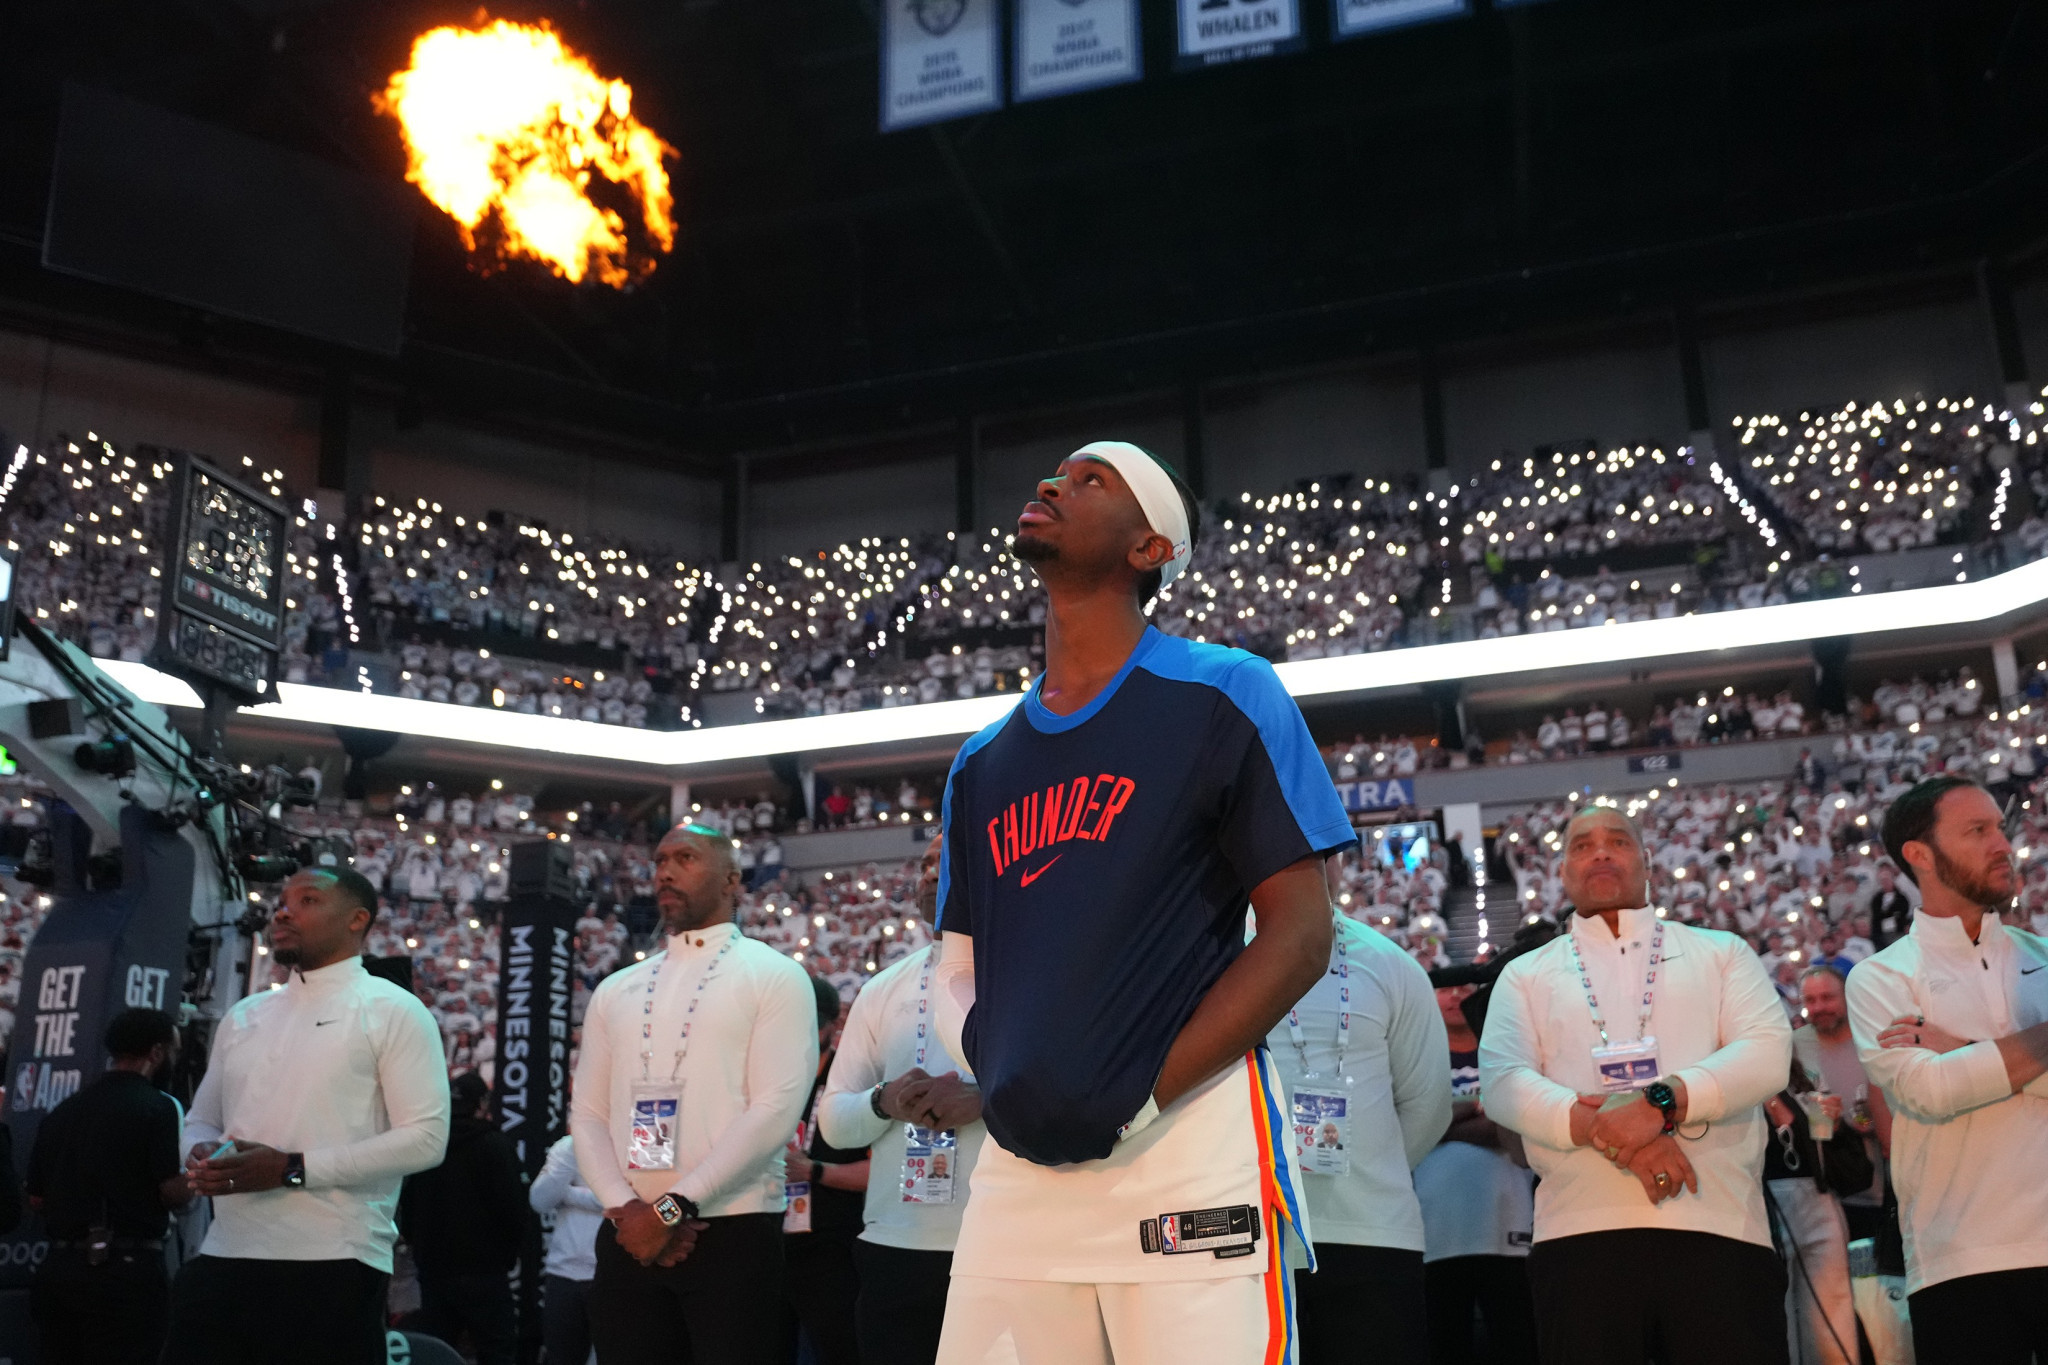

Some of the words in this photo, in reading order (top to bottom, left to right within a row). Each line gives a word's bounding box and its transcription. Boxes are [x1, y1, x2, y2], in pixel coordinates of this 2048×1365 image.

[1198, 9, 1278, 38] WHALEN
[1029, 47, 1123, 77] CHAMPIONS
[898, 76, 984, 106] CHAMPIONS
[210, 586, 278, 631] TISSOT
[987, 773, 1136, 877] THUNDER
[38, 965, 86, 1011] GET
[125, 964, 170, 1010] GET
[33, 1011, 80, 1058] THE
[501, 924, 535, 1133] MINNESOTA
[546, 926, 570, 1131] MINNESOTA
[1183, 1222, 1193, 1231] 48
